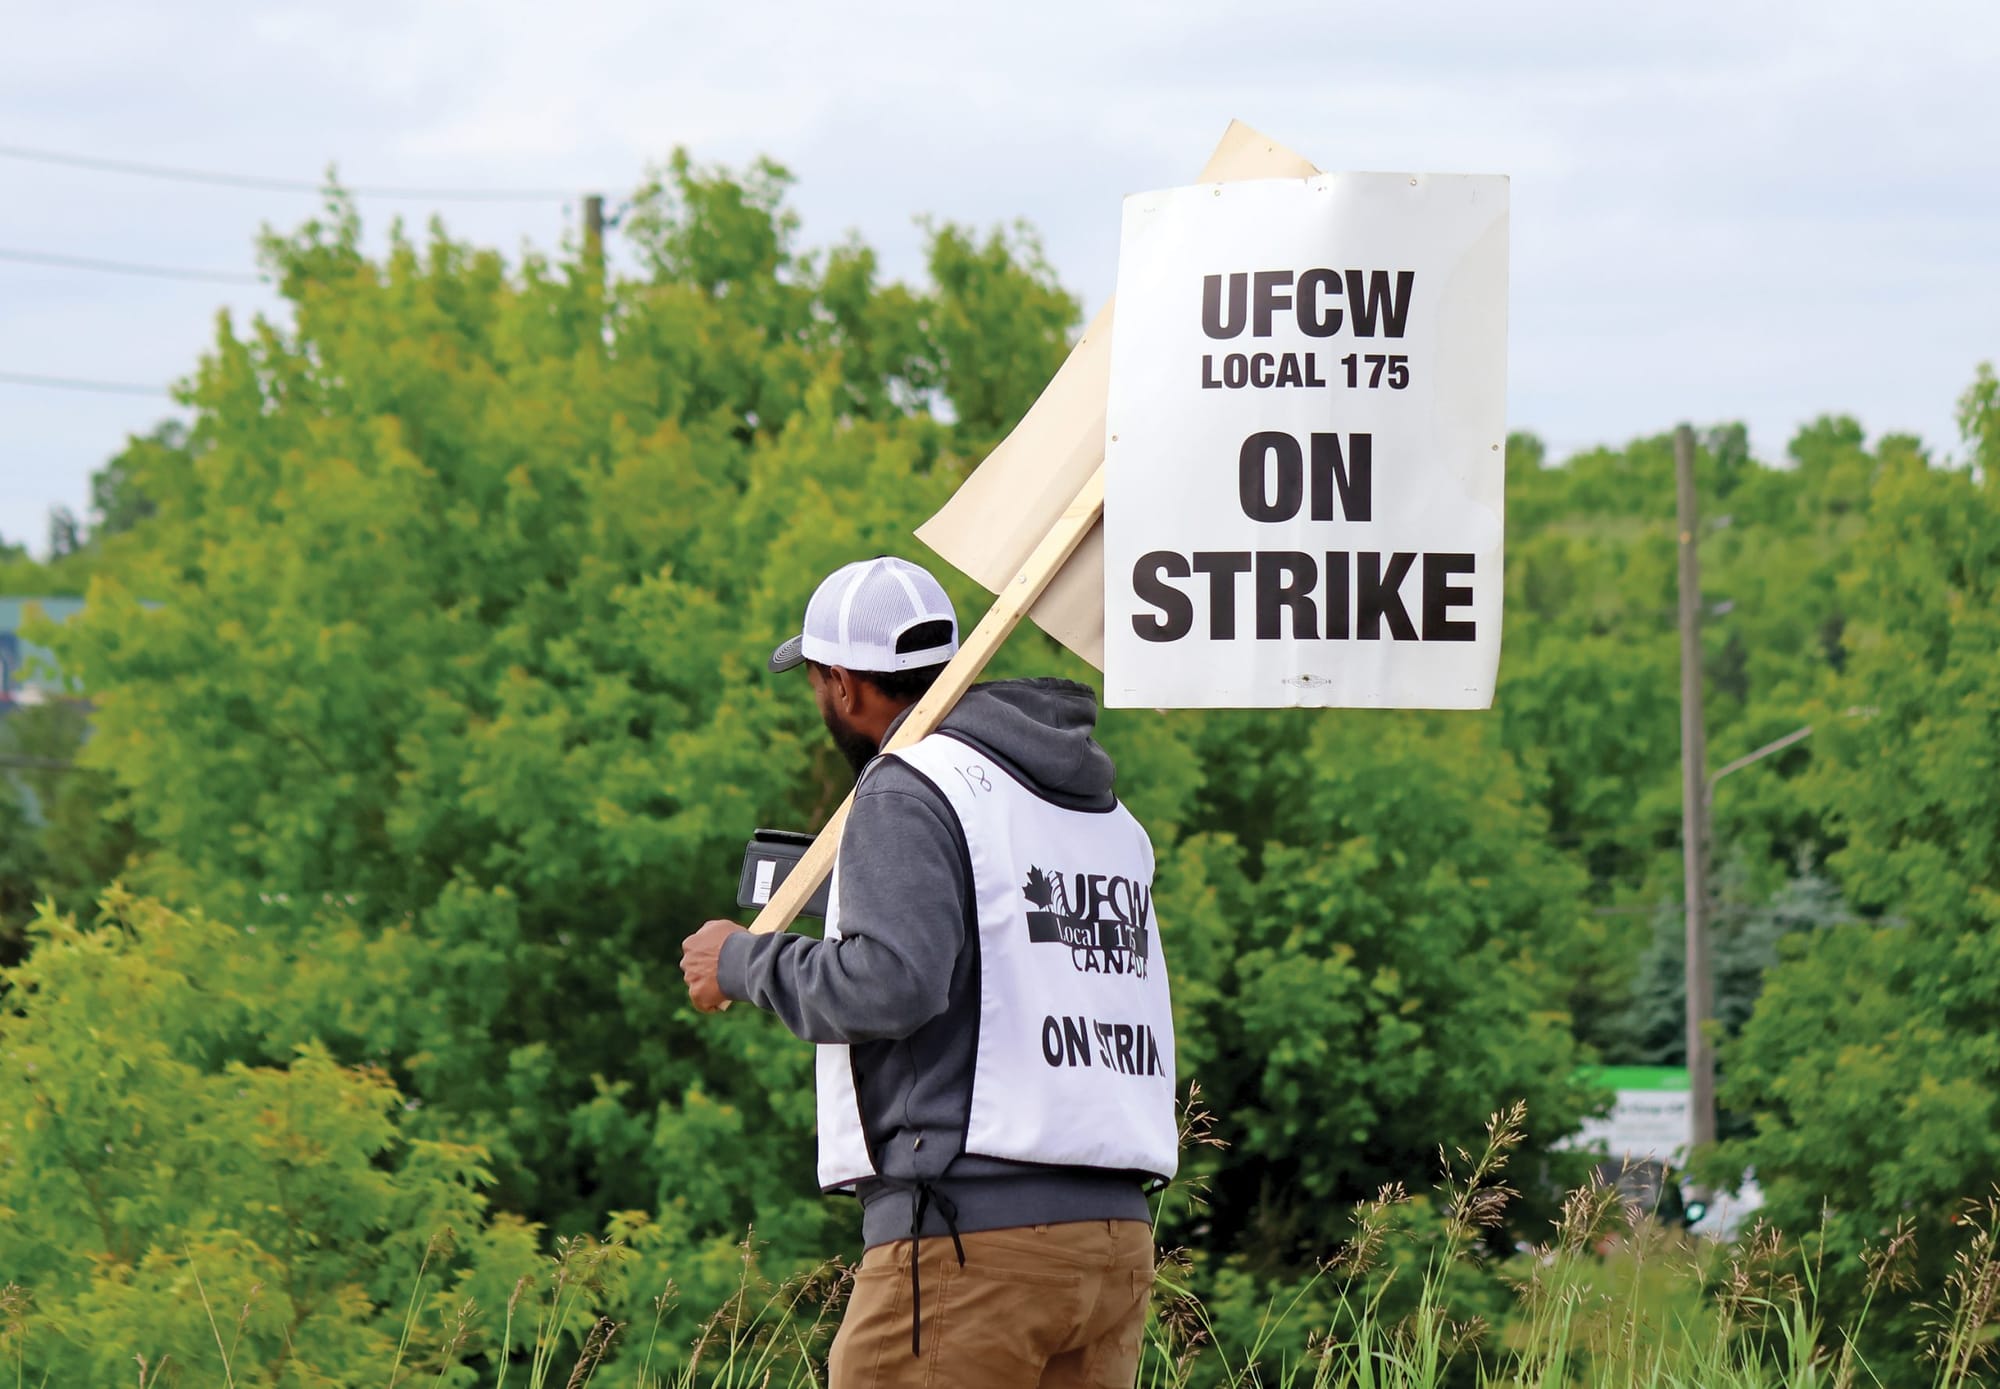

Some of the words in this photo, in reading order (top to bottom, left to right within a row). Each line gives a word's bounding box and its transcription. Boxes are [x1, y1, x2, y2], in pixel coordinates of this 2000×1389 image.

[1202, 268, 1415, 340] UFCW
[1202, 352, 1326, 389] LOCAL
[1341, 353, 1410, 390] 175
[1239, 431, 1372, 523] ON
[1131, 550, 1477, 643] STRIKE
[1055, 871, 1149, 930] UFCW
[1056, 917, 1101, 947] Local
[1041, 1015, 1092, 1067] ON
[1093, 1018, 1166, 1078] STRIK
